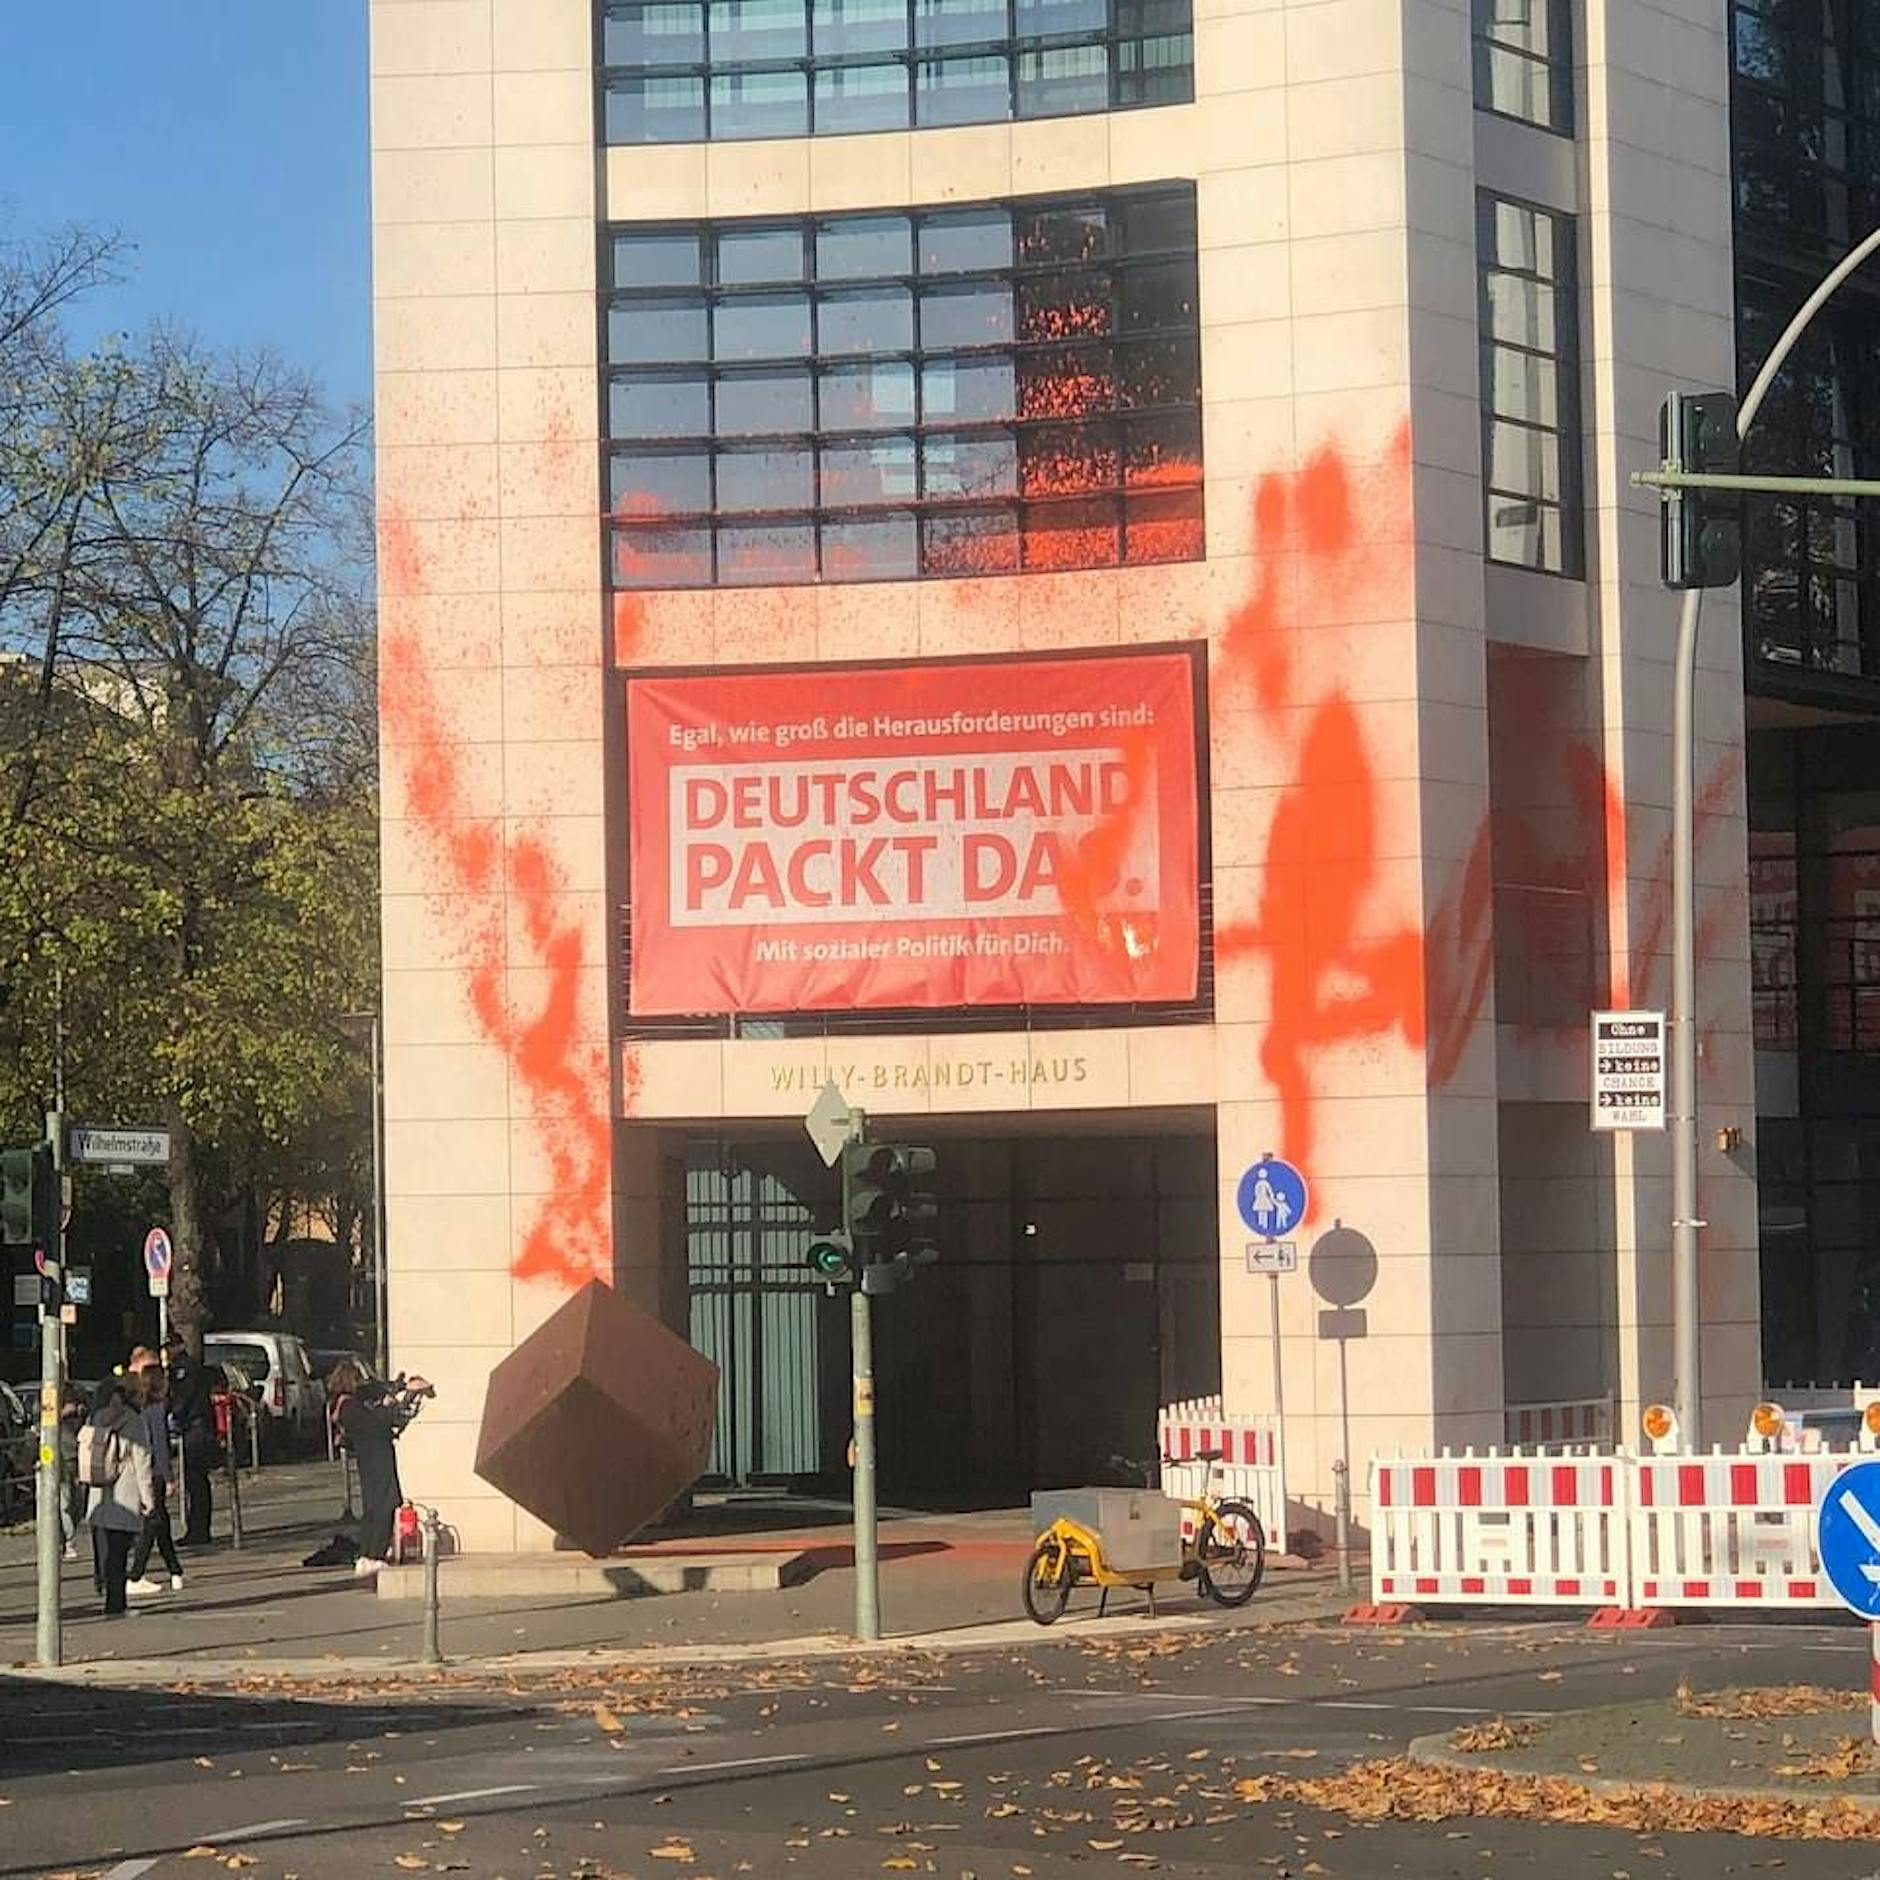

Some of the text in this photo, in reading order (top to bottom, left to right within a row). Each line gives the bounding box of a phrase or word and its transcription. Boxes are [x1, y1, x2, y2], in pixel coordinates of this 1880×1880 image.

[668, 703, 1155, 751] Egal, wie groß die Herausforderungen sind:
[686, 762, 1139, 831] DEUTSCHLAND
[686, 835, 938, 910] PACKT
[756, 931, 1071, 962] Mit sozialer Politik für Dich.
[1614, 1059, 1659, 1072] keine
[1614, 1094, 1659, 1106] keine
[78, 1133, 161, 1157] Wilhelmstraße
